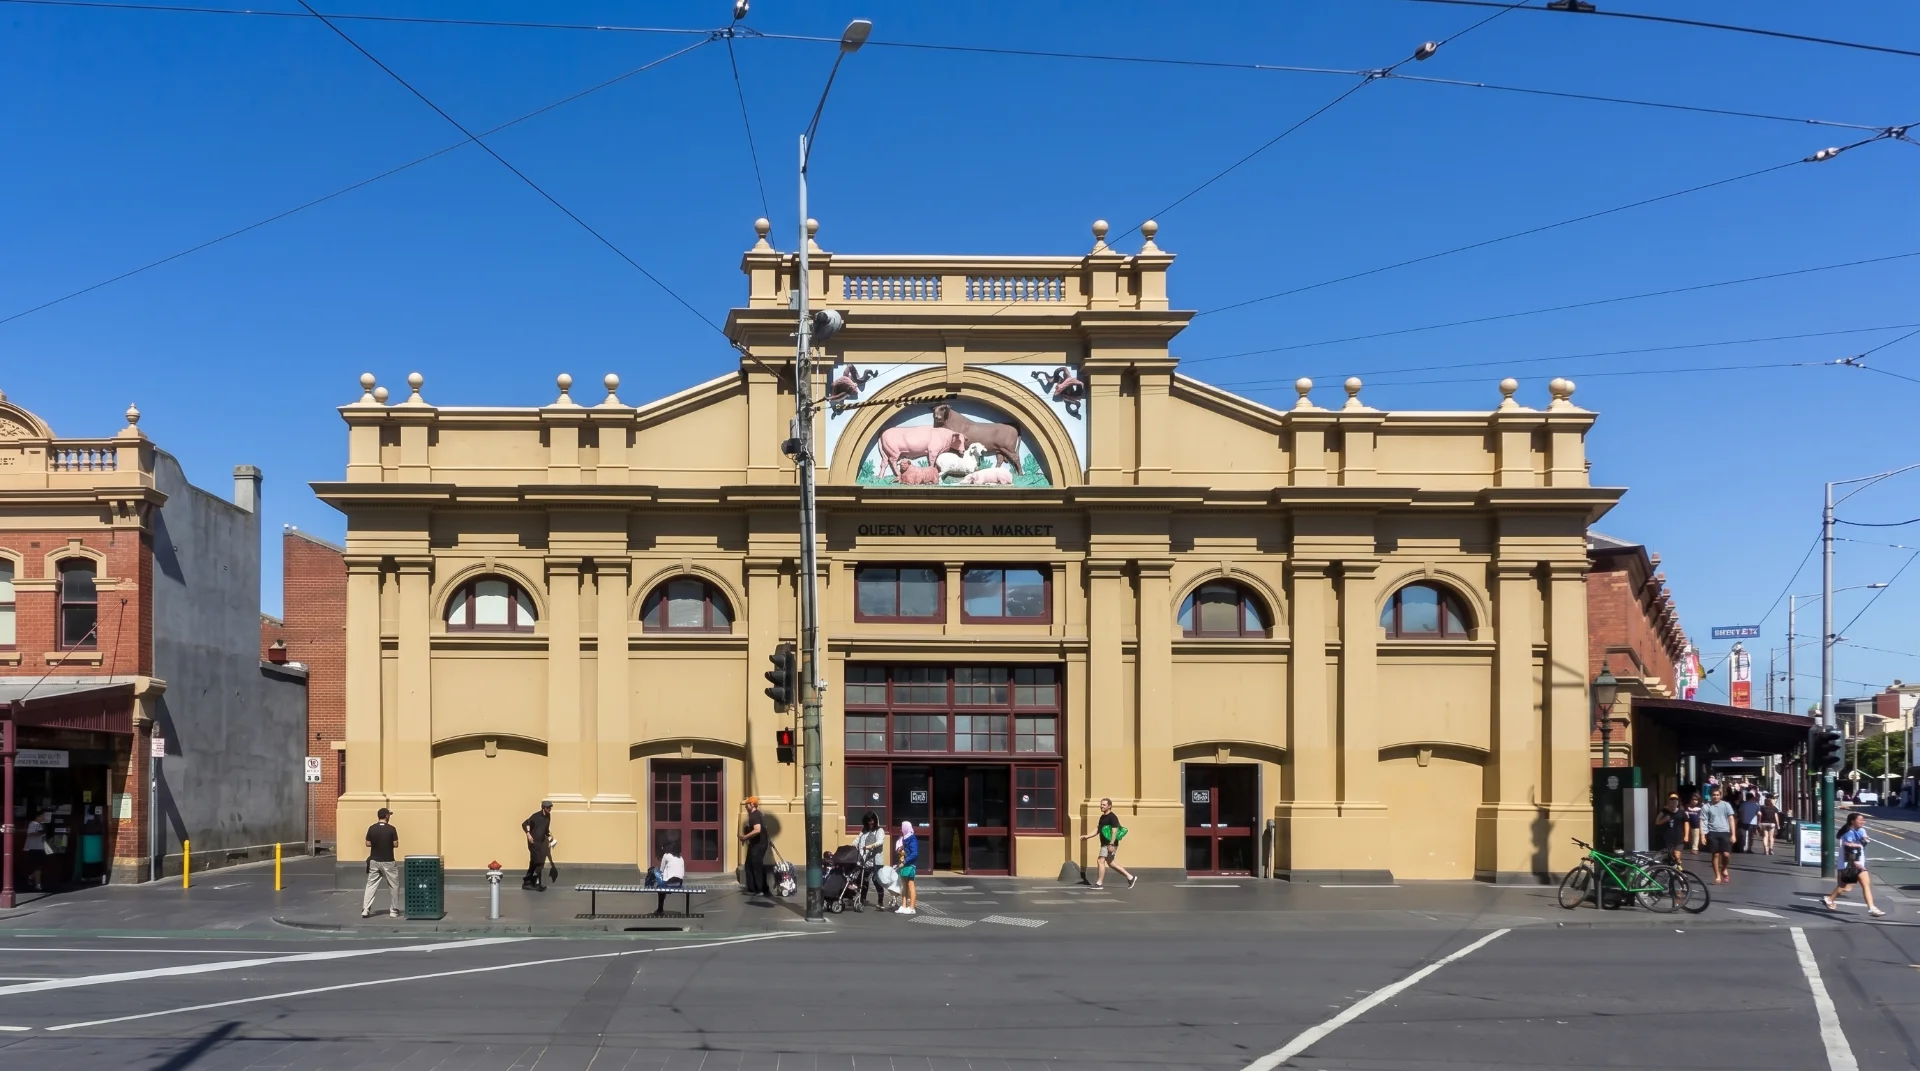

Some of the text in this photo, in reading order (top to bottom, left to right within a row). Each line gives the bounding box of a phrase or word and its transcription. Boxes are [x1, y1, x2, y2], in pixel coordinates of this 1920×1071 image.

[857, 524, 1054, 536] QUEEN VICTORIA MARKET
